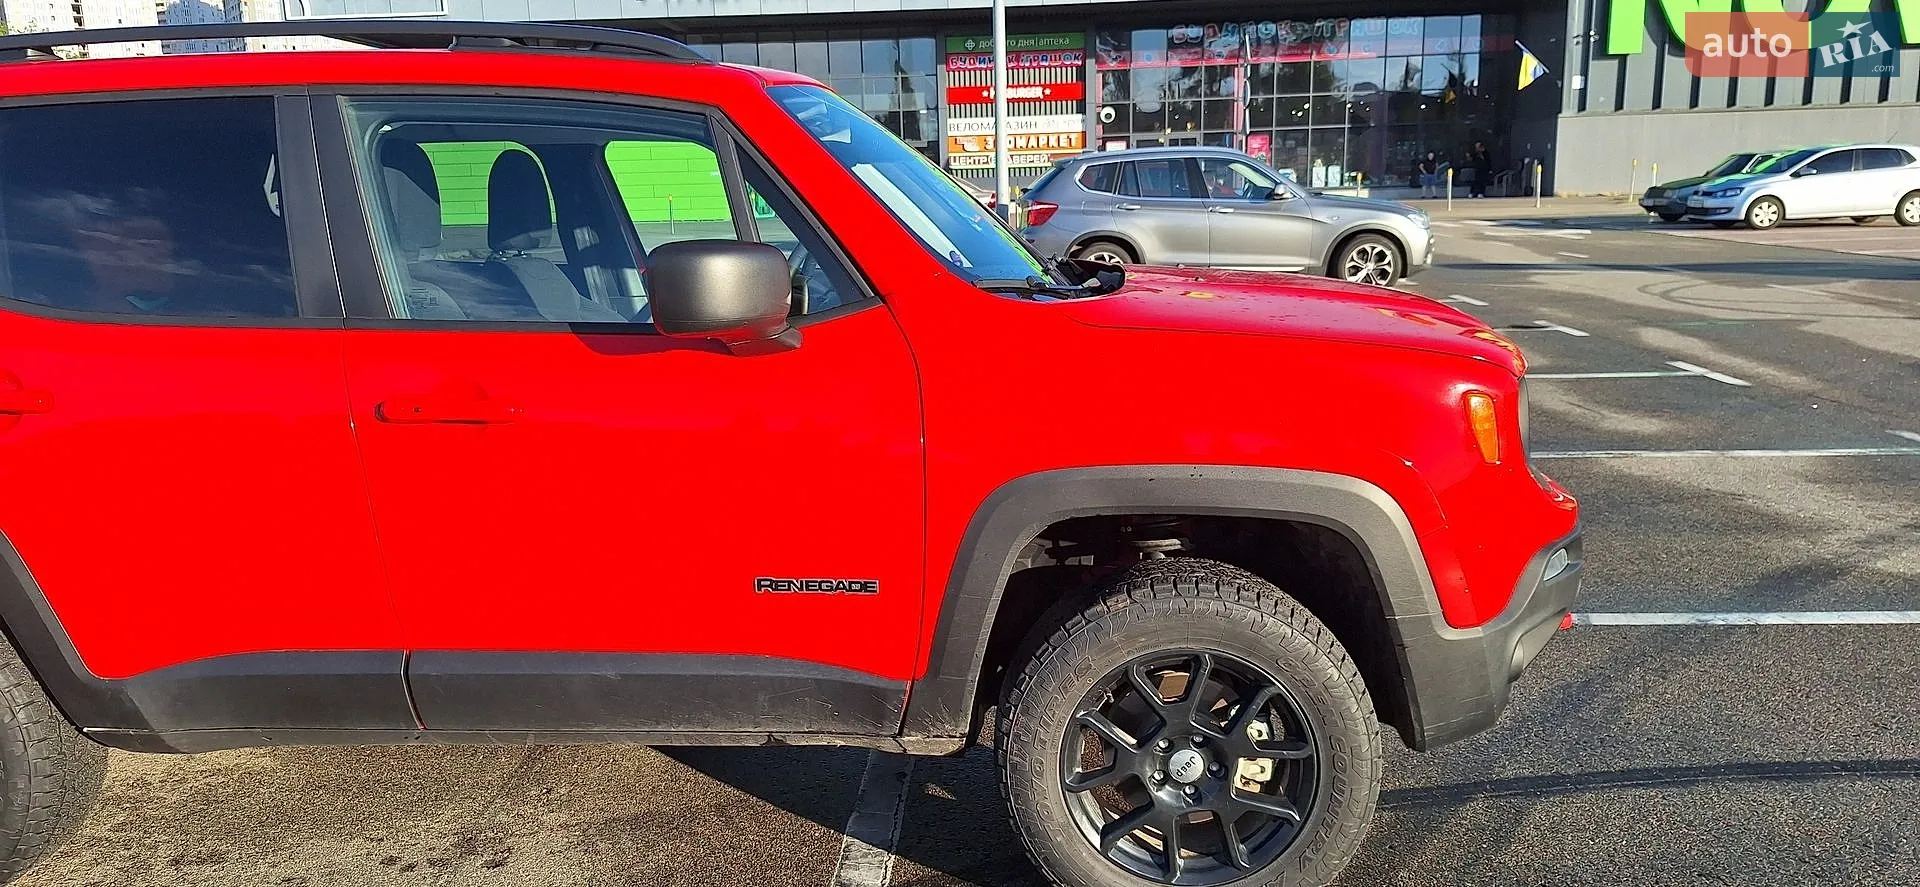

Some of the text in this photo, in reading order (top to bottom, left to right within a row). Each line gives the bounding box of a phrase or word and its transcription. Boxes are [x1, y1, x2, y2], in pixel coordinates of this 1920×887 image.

[1018, 39, 1035, 48] дня
[1039, 37, 1070, 46] аптека
[949, 54, 1017, 69] БУДИНК
[949, 121, 1037, 131] ВЕЛОМАЗИН
[984, 134, 1078, 150] ЗОМАРКЕТ
[756, 577, 879, 594] RENEGADE
[1176, 756, 1197, 777] Jeep
